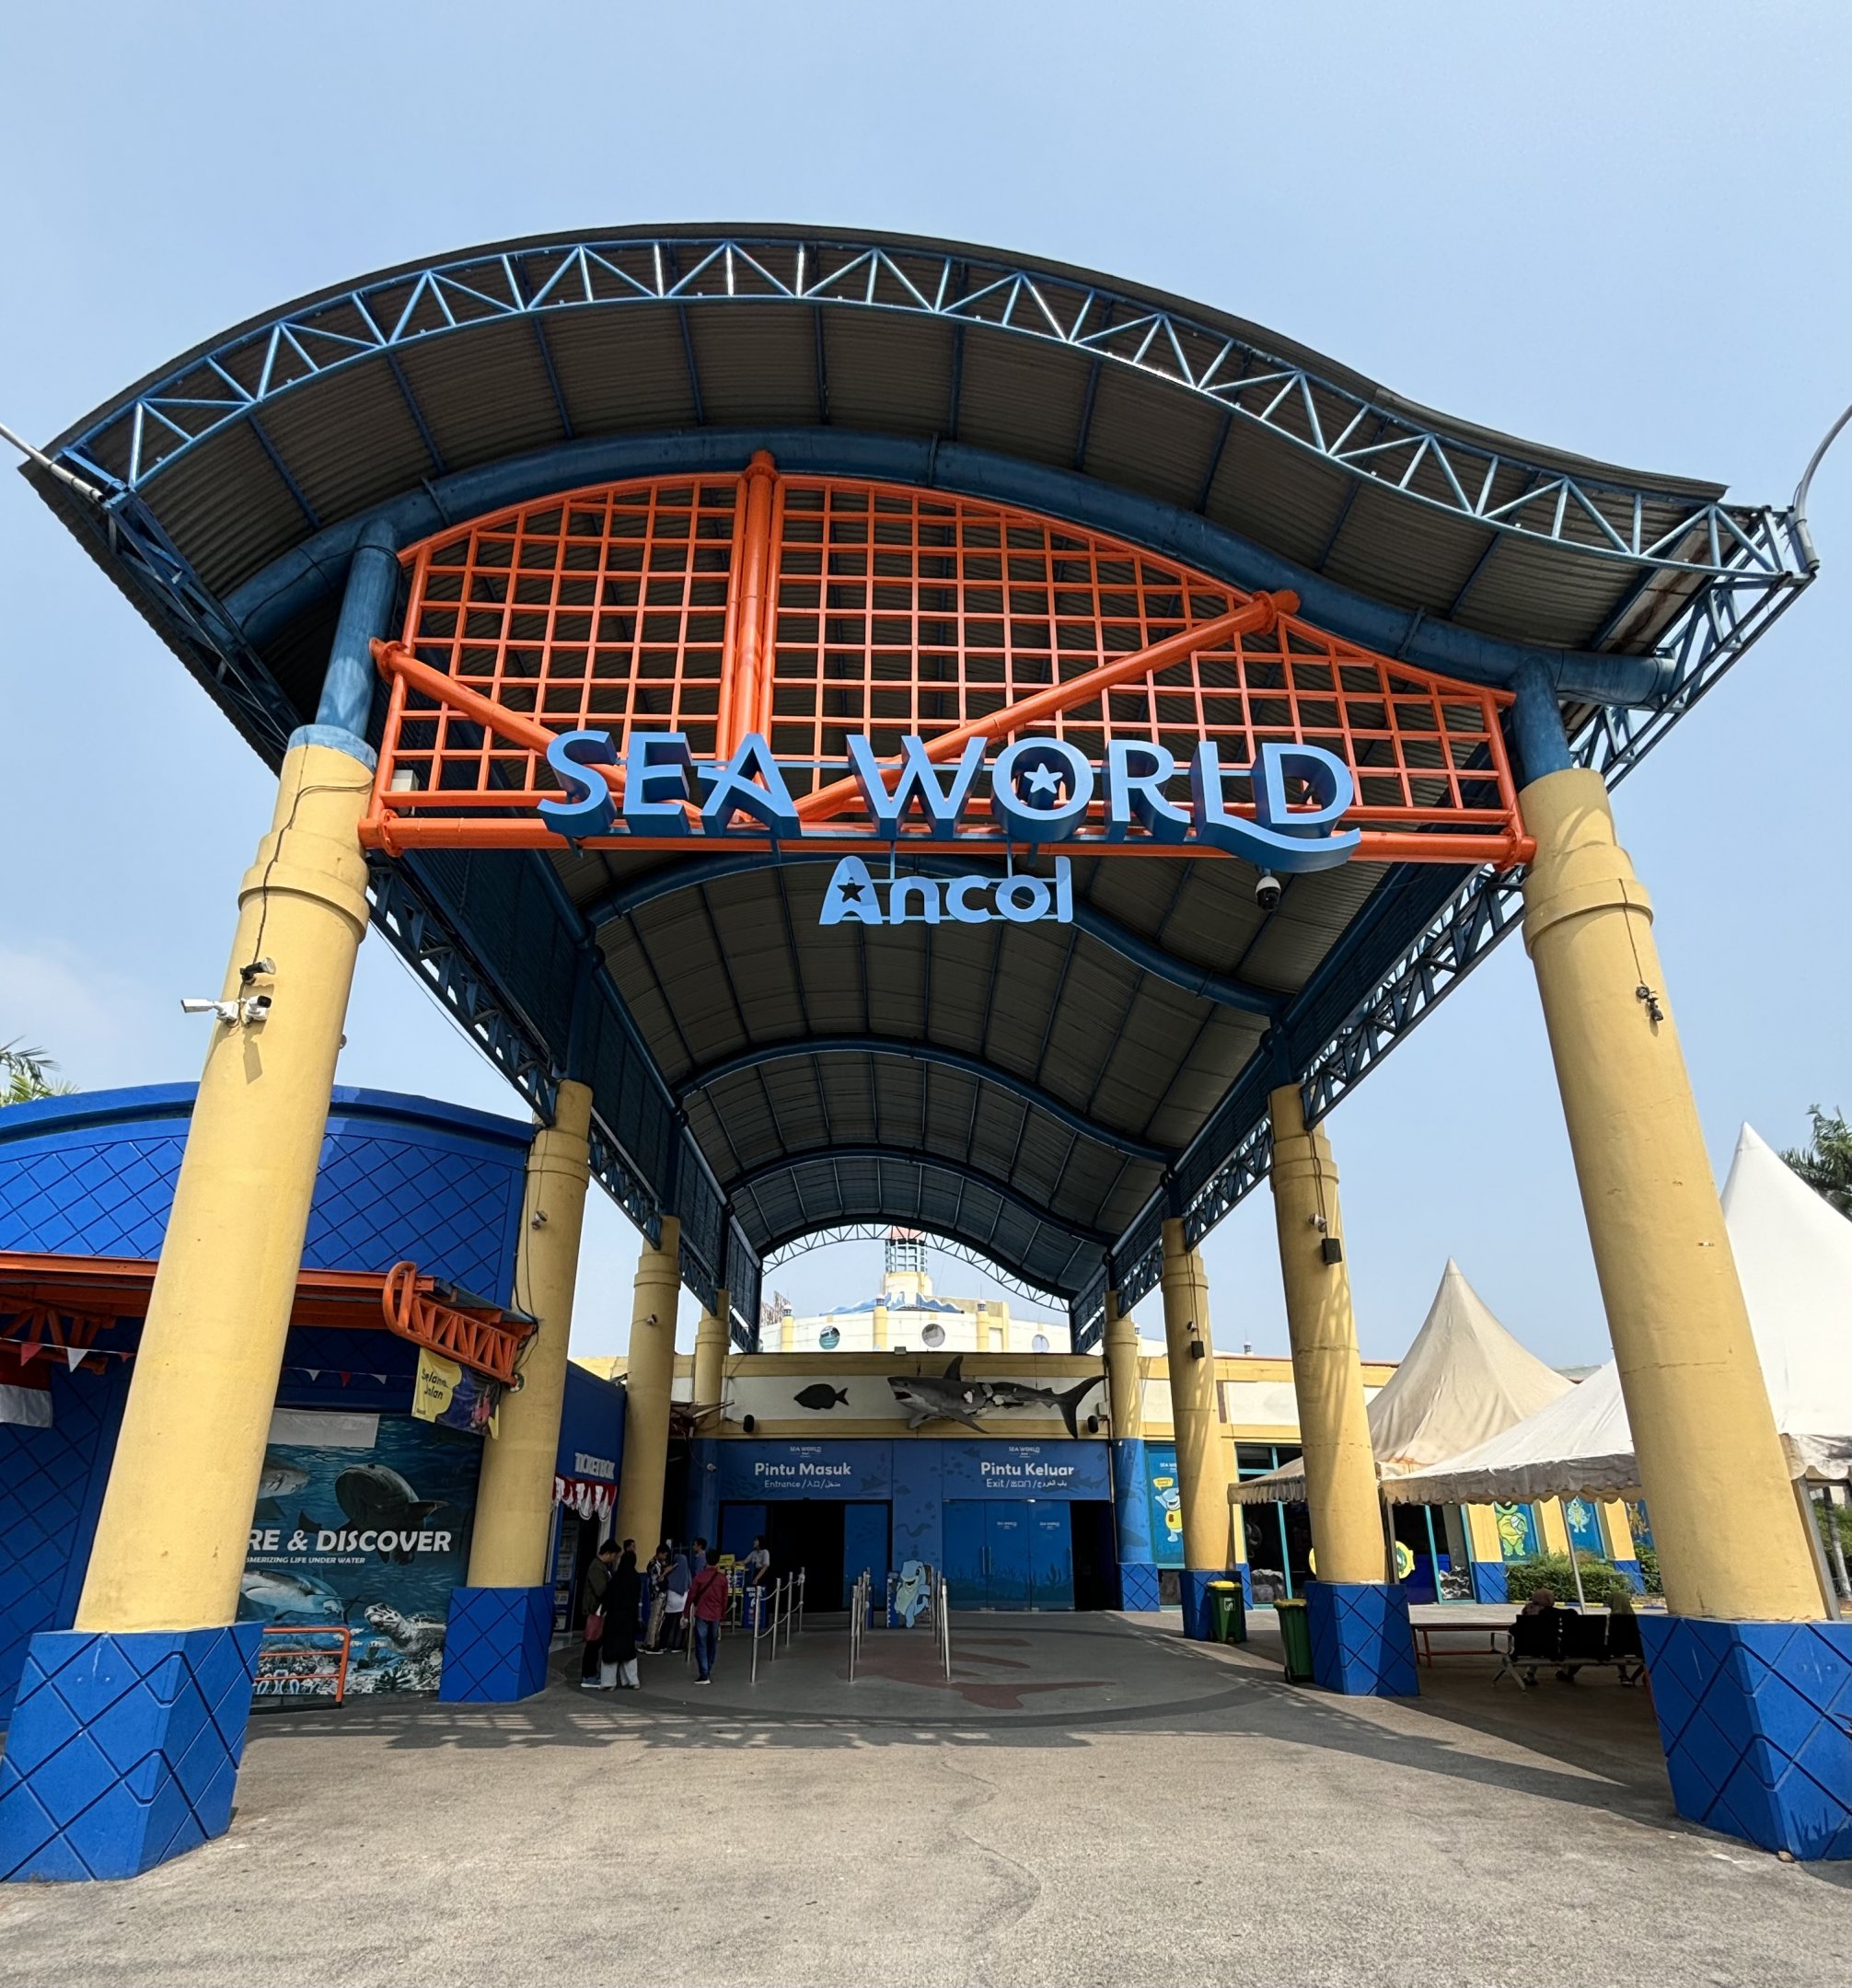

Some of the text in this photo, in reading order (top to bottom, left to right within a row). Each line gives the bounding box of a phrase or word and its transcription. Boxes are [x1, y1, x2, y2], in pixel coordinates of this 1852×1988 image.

[538, 730, 1362, 871] SEA WORLD
[818, 855, 1073, 926] Ancol
[755, 1462, 851, 1475] Pintu Masuk
[980, 1462, 1075, 1476] Pintu Keluar
[287, 1529, 308, 1552] &
[316, 1530, 452, 1553] DISCOVER
[290, 1556, 308, 1565] LIFE
[308, 1556, 337, 1565] UNDER
[337, 1556, 366, 1565] WATER
